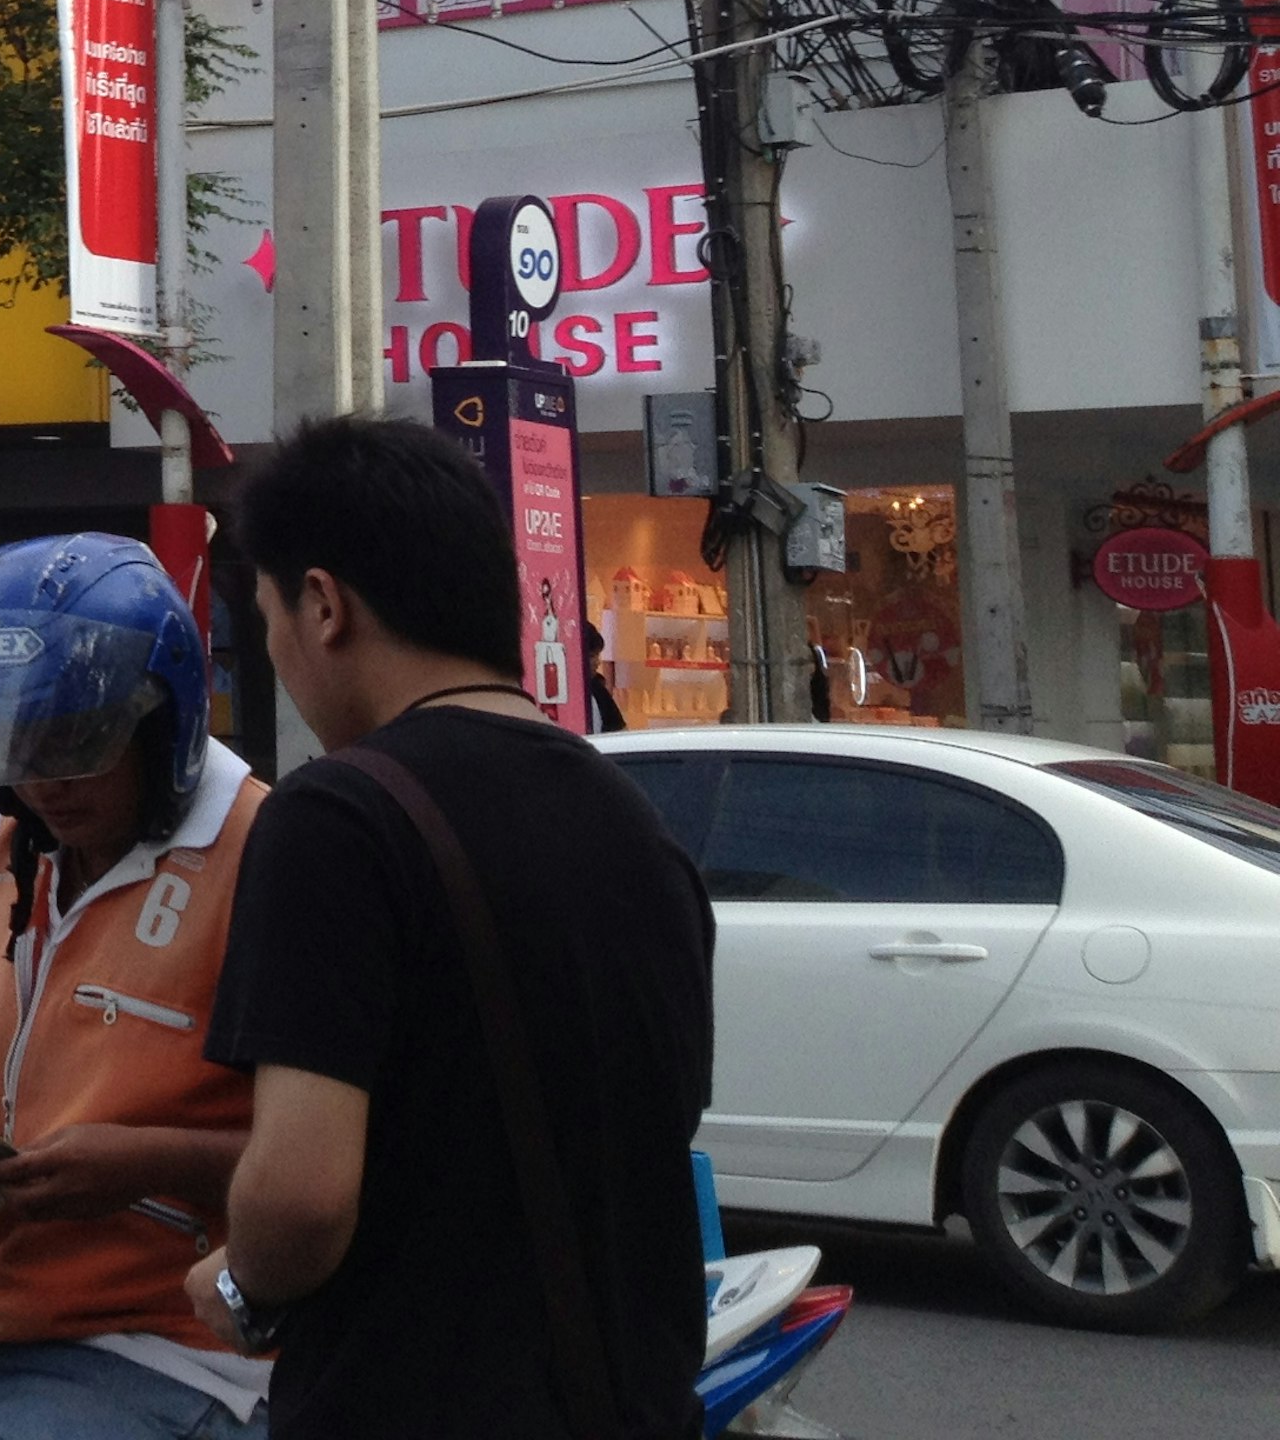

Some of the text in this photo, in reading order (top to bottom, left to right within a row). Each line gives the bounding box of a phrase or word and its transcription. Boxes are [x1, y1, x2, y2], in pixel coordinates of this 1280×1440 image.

[508, 310, 529, 338] 10
[1107, 551, 1198, 574] ETUDE
[1121, 575, 1184, 590] HOUSE
[134, 871, 192, 949] 6
